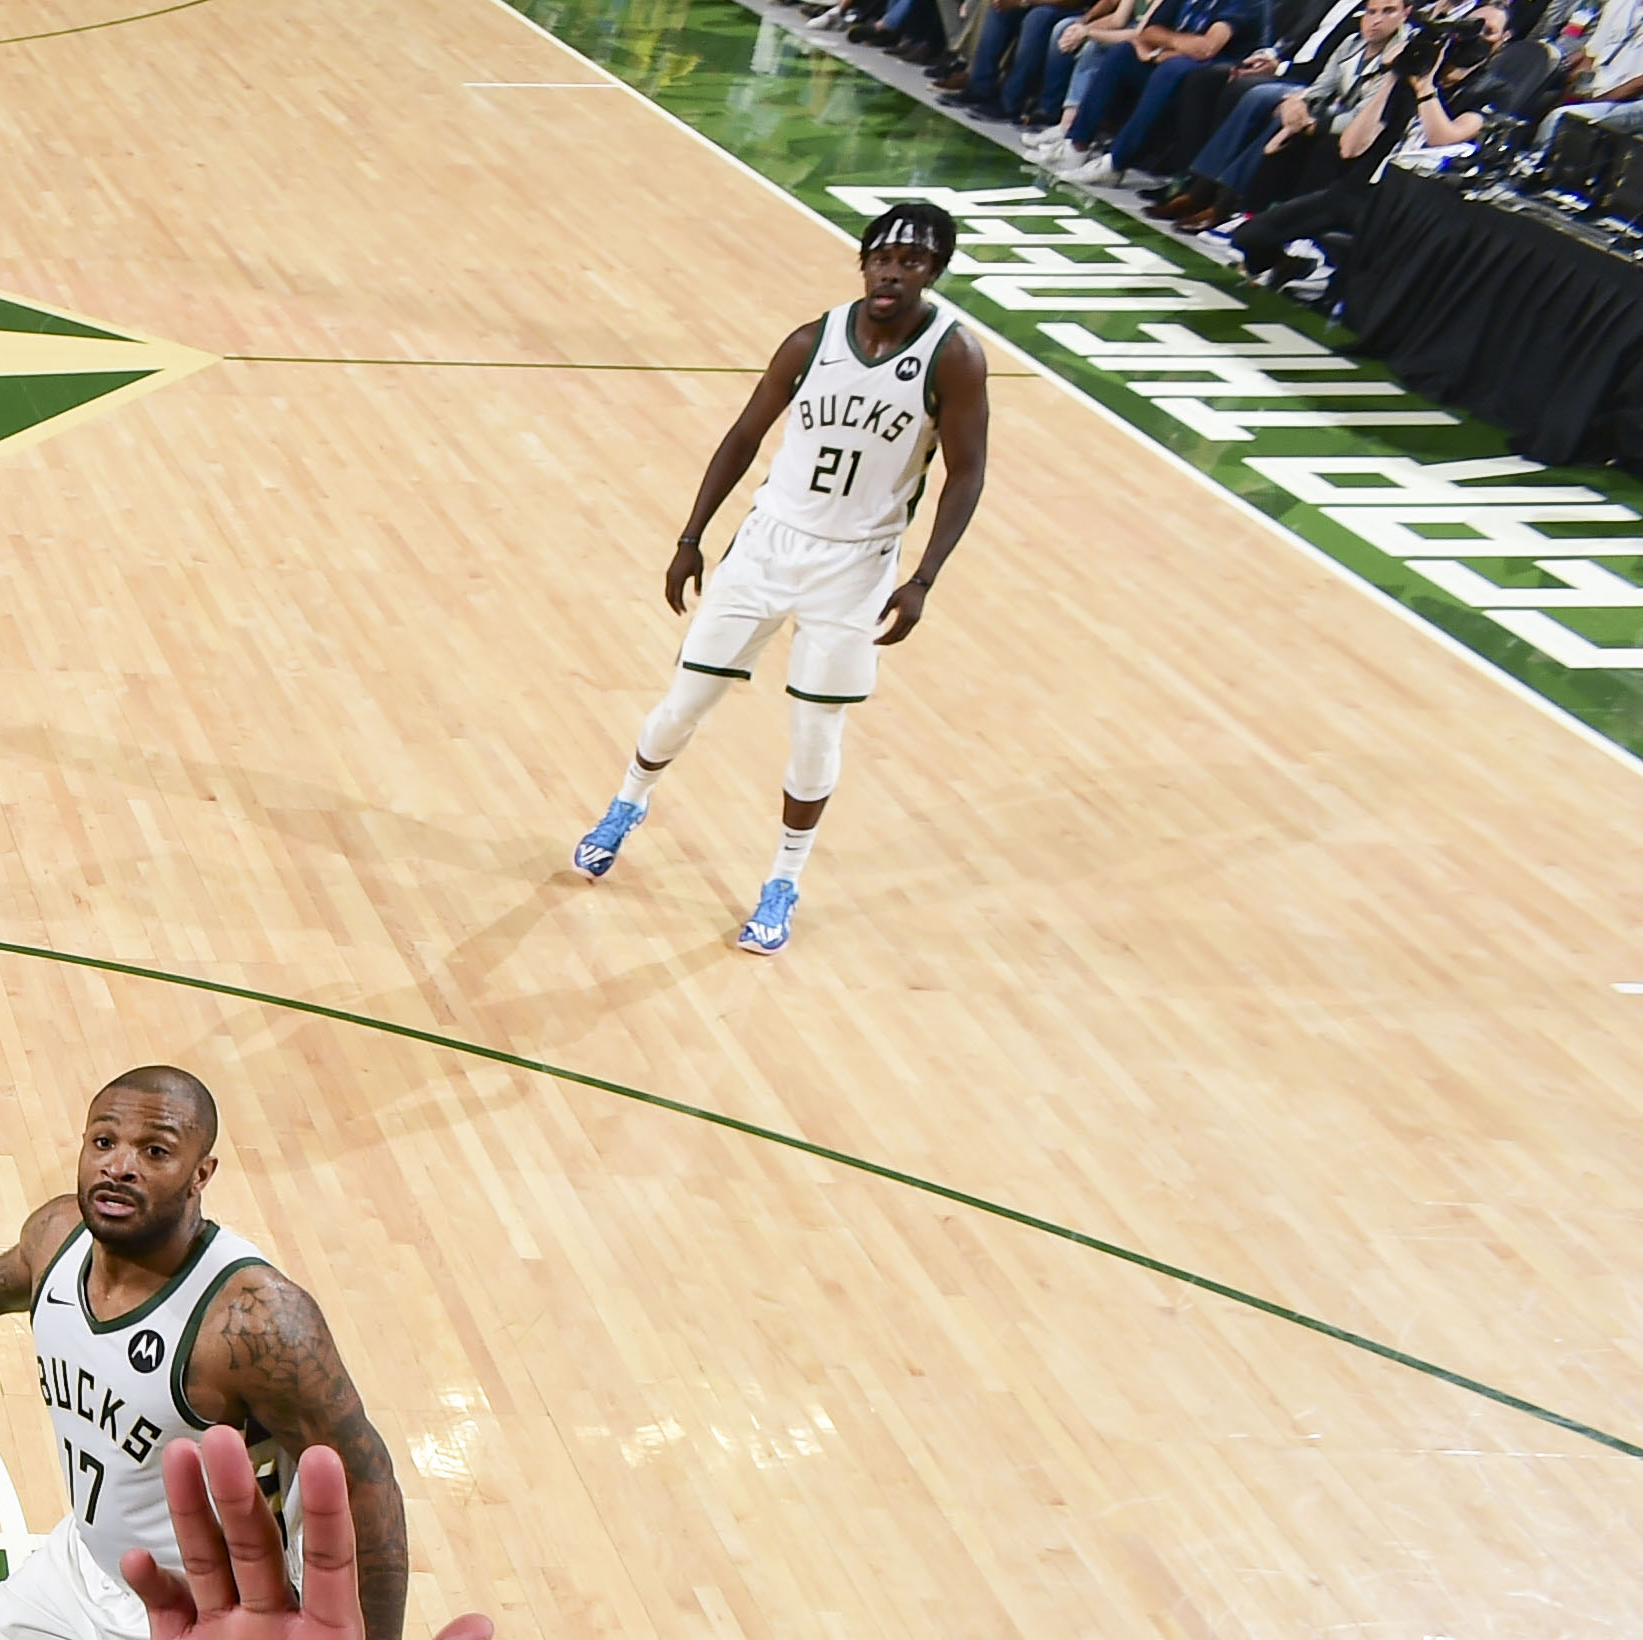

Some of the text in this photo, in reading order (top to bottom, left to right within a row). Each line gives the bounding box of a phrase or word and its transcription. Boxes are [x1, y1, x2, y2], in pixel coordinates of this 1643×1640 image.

[799, 394, 914, 444] BUCKS
[809, 446, 863, 498] 21
[37, 1353, 163, 1464] BUCKS
[63, 1436, 106, 1528] 17
